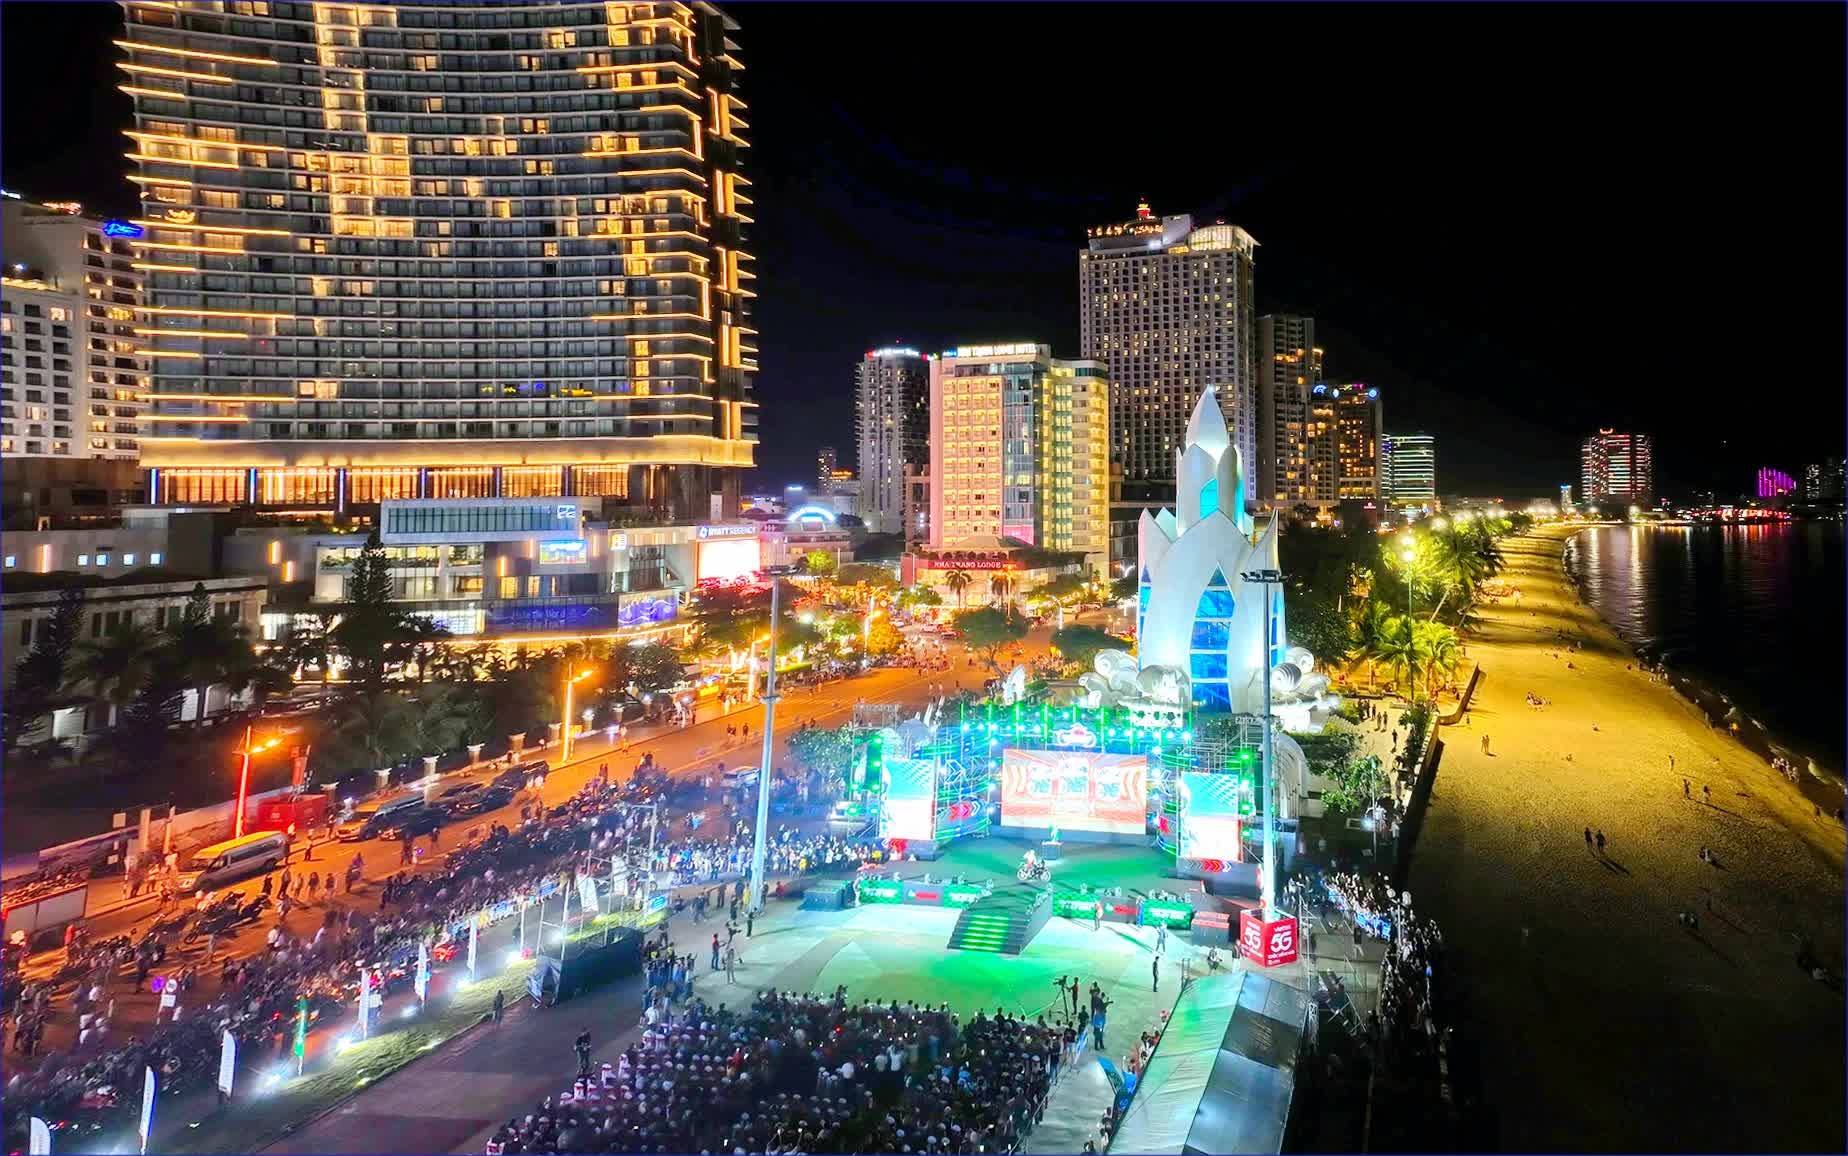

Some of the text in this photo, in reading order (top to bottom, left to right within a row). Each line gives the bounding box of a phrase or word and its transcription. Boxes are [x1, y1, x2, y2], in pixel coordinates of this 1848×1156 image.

[934, 561, 950, 569] NHA
[952, 561, 976, 569] TRANG
[977, 561, 1001, 569] LODGE
[1270, 931, 1292, 952] 5G
